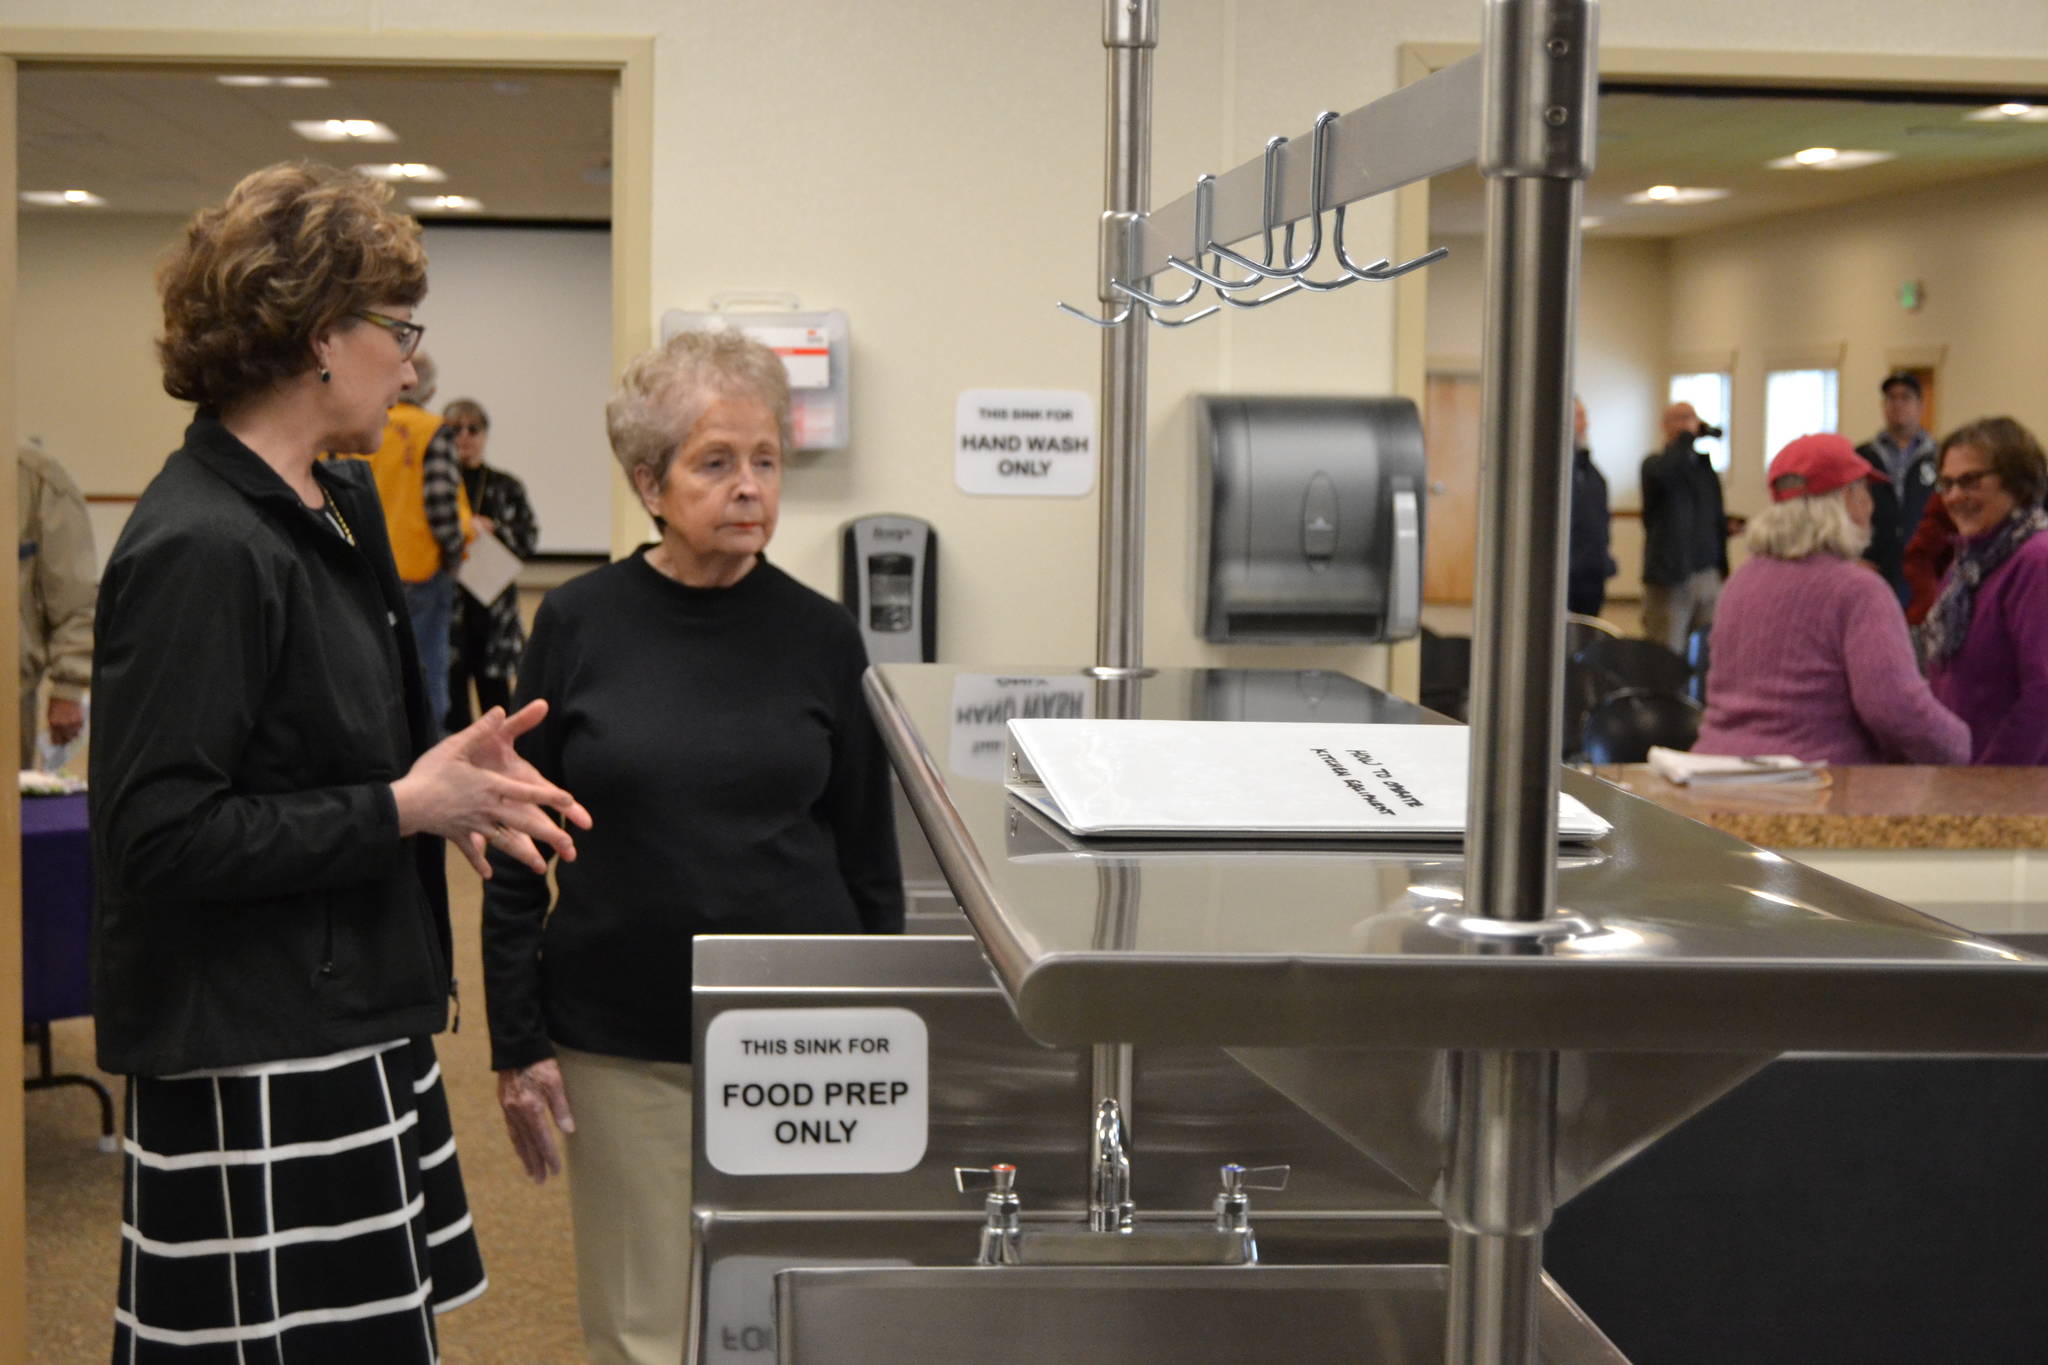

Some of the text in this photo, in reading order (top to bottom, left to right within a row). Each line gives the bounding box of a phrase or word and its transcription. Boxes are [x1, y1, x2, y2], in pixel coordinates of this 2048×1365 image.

[978, 407, 1073, 420] THIS SINK FOR
[962, 435, 1088, 453] HAND WASH
[998, 459, 1052, 476] ONLY
[1310, 748, 1396, 815] KITCHEN EQUIPMENT
[1345, 749, 1424, 807] HOW TO OPERATE
[741, 1038, 890, 1055] THIS SINK FOR
[723, 1082, 908, 1107] FOOD PREP
[775, 1120, 857, 1144] ONLY
